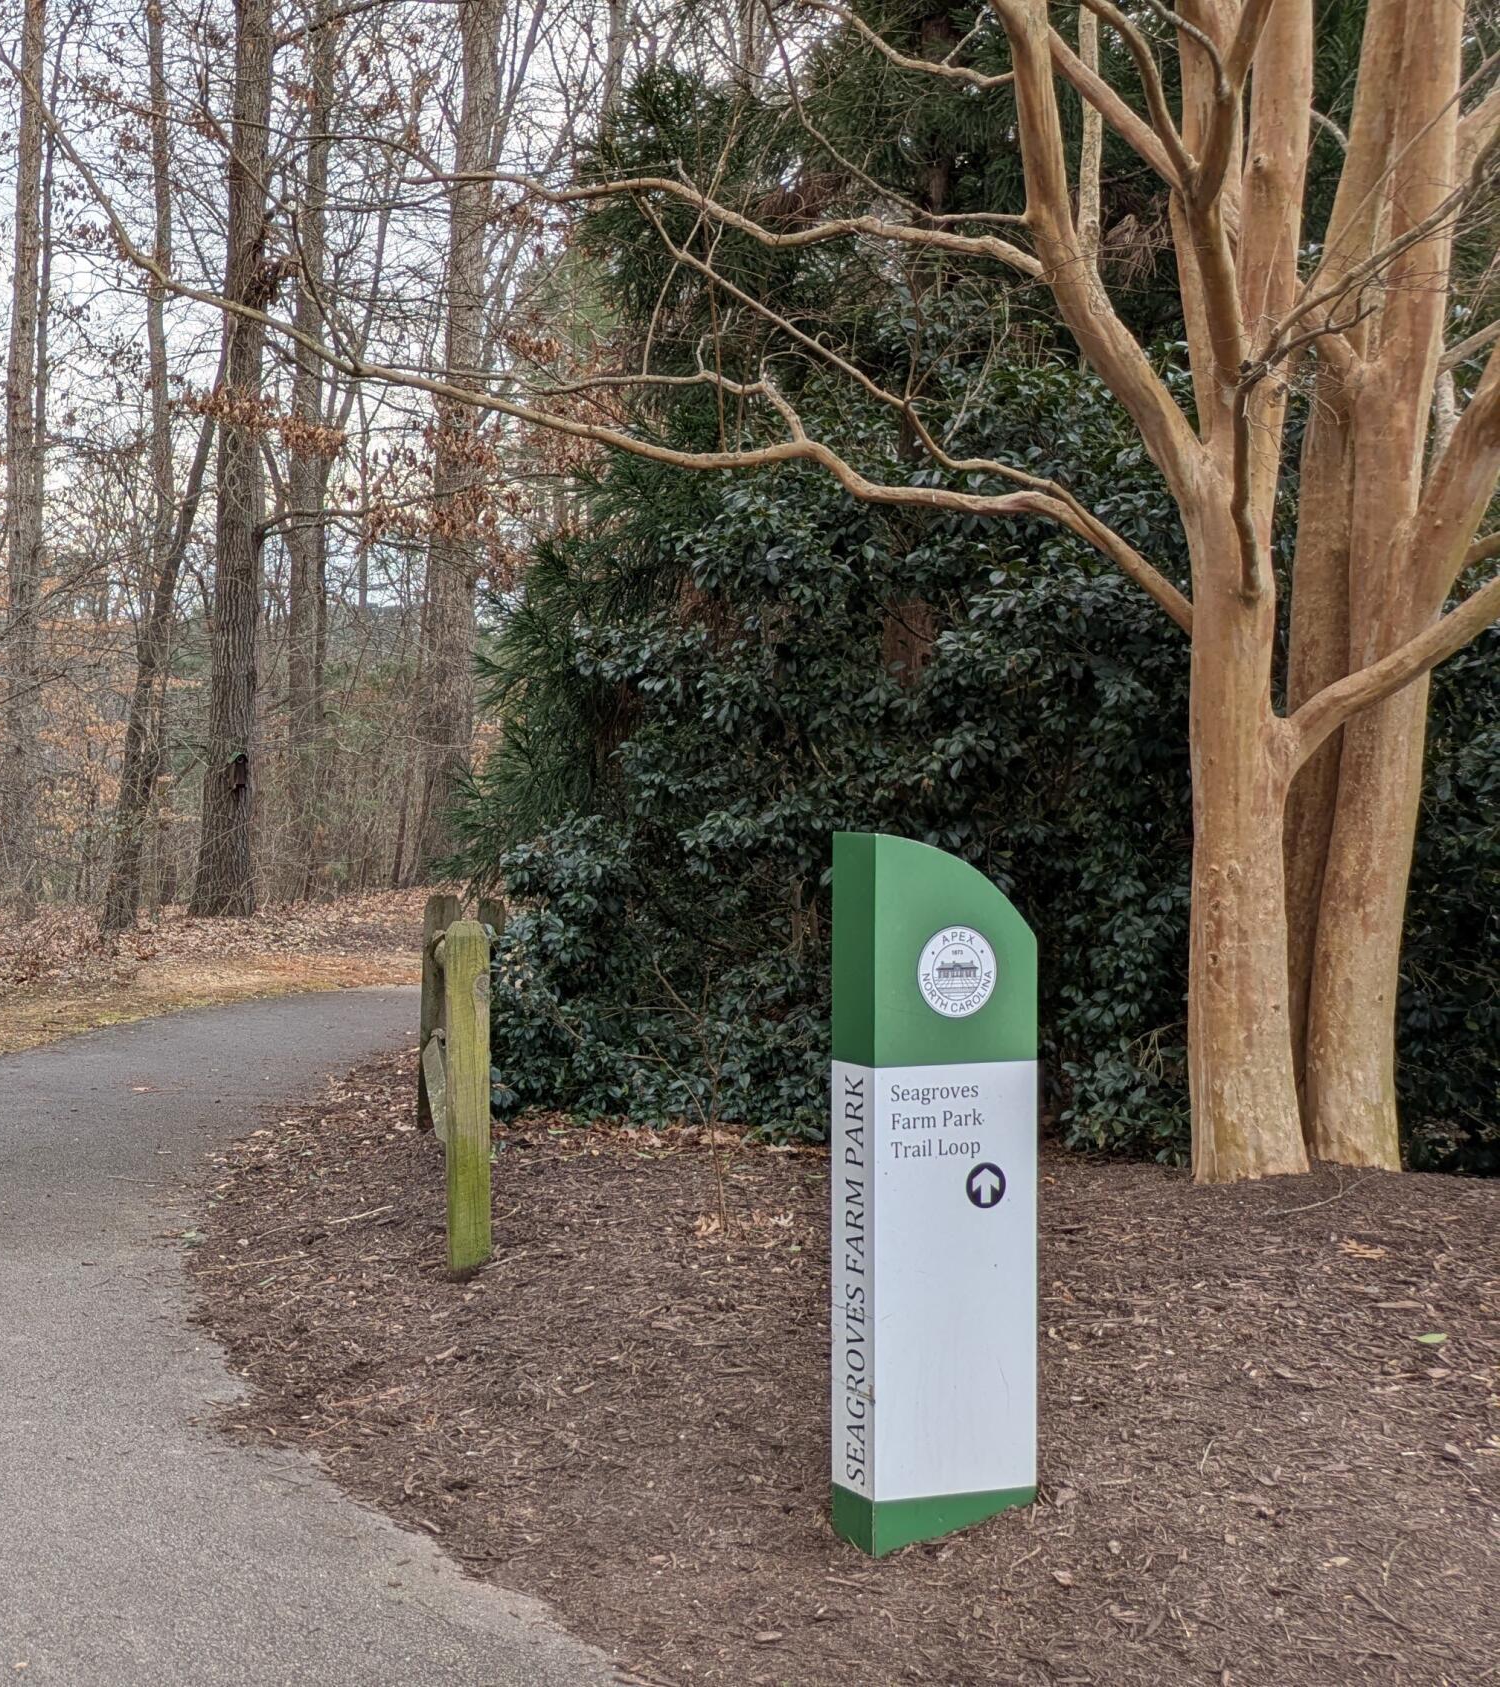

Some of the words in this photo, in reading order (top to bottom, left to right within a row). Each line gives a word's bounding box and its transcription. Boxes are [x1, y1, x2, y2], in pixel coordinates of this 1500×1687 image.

[941, 931, 975, 945] APEX
[922, 972, 949, 1010] NORTH
[950, 970, 993, 1013] CAROLINA
[891, 1084, 979, 1105] Seagroves
[845, 1075, 864, 1169] PARK
[891, 1113, 936, 1131] Farm
[942, 1108, 983, 1128] Park
[891, 1139, 932, 1159] Trail
[938, 1139, 981, 1159] Loop
[845, 1177, 865, 1276] FARM
[846, 1283, 865, 1486] SEAGROVES
